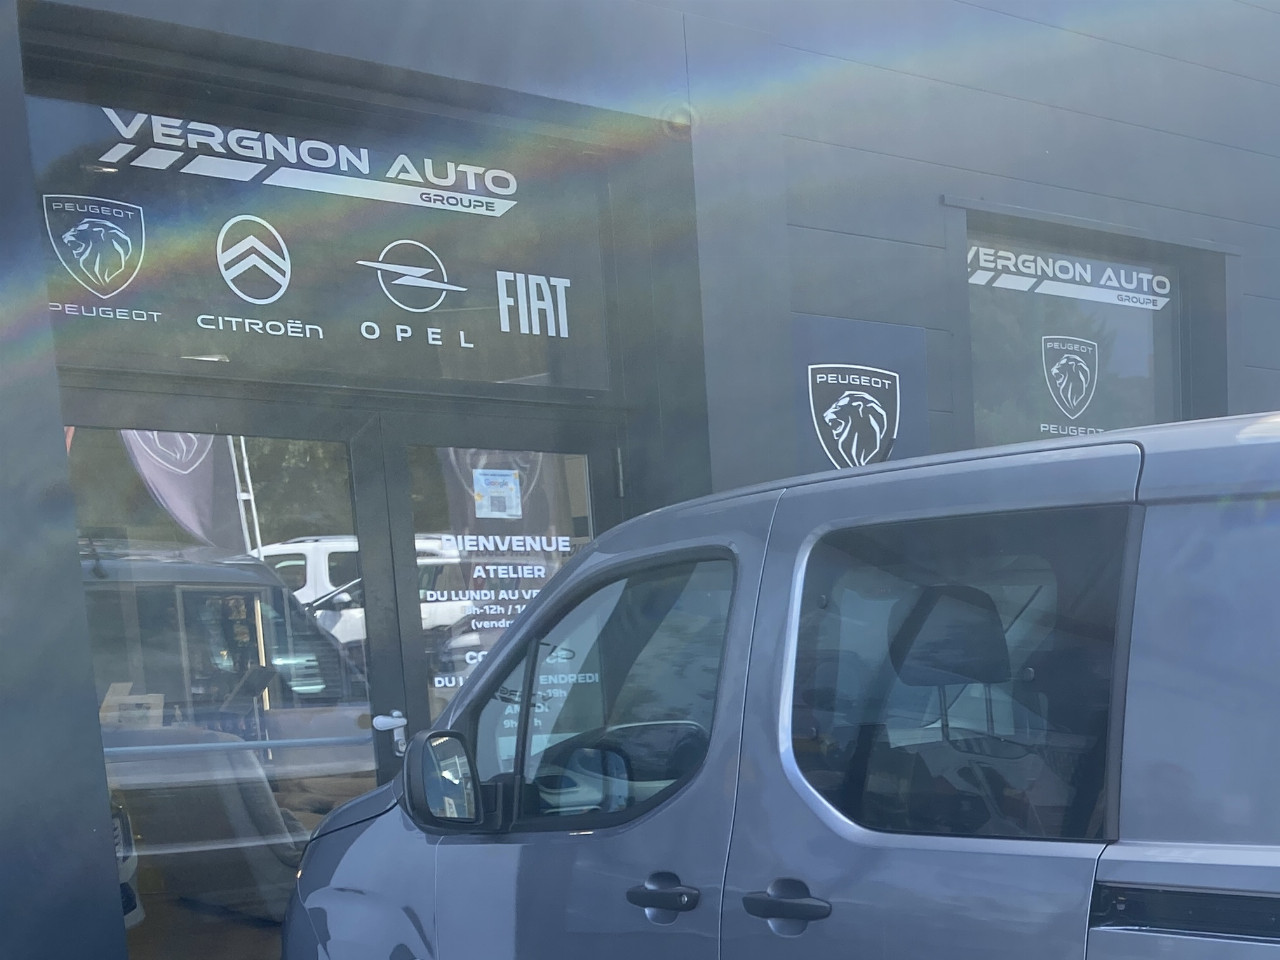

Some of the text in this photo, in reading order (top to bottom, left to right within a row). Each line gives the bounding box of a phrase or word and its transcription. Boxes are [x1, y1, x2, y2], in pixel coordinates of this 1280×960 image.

[101, 106, 518, 196] VERGNON AUTO
[419, 192, 496, 212] GROUPE
[52, 202, 135, 220] PEUGEOT
[1099, 267, 1171, 295] AUTO
[496, 270, 571, 338] FIAT
[1116, 294, 1159, 307] GROUPE
[360, 321, 474, 349] OPEL
[1046, 342, 1093, 354] PEUGEOT
[816, 373, 892, 390] PEUGEOT
[441, 535, 571, 552] BIENVENUE
[473, 565, 546, 578] ATELIER
[426, 590, 448, 601] DU
[451, 590, 495, 601] LUNDI
[498, 590, 519, 600] AU
[434, 677, 455, 688] DU
